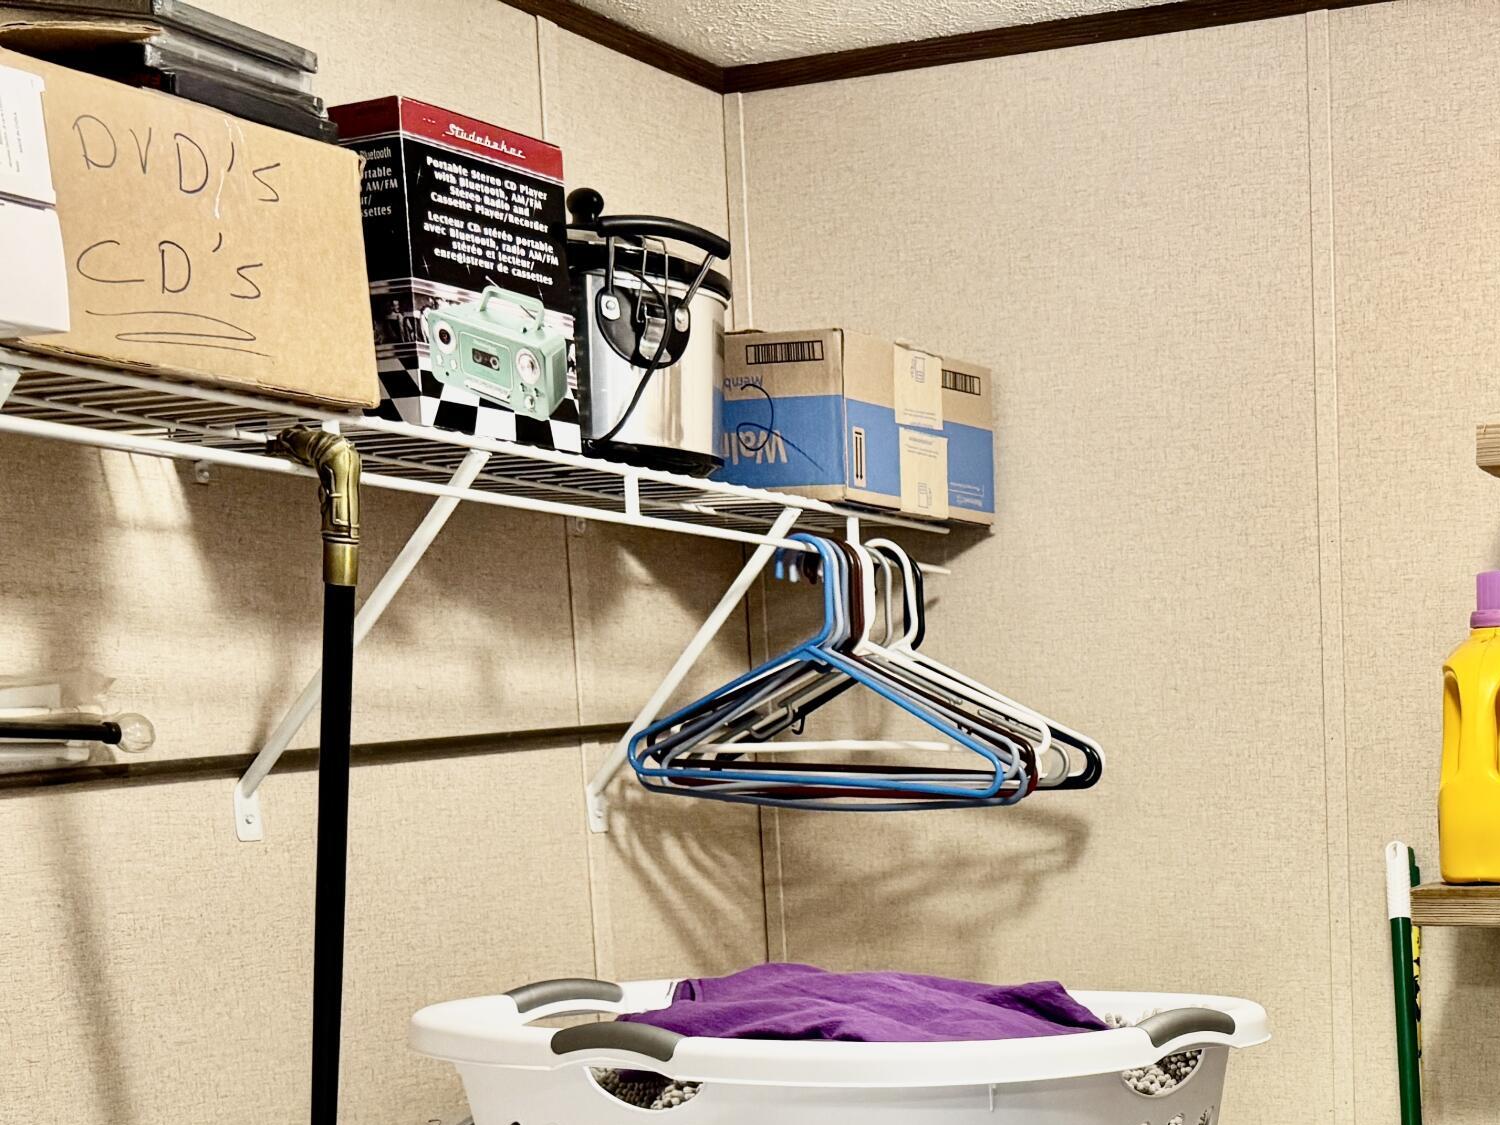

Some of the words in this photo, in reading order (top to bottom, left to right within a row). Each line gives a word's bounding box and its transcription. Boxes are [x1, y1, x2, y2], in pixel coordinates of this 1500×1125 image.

[72, 114, 281, 202] DVD's
[445, 123, 526, 159] Studebaker
[364, 166, 392, 179] rtable
[366, 178, 398, 191] AM/FM
[426, 155, 469, 177] Portable
[470, 169, 502, 187] Stereo
[504, 180, 517, 191] CD
[519, 184, 548, 200] Player
[433, 170, 457, 184] with
[458, 177, 509, 201] Bluetooth,
[511, 193, 542, 210] AM/FM
[430, 191, 473, 212] Cassette
[474, 203, 549, 233] Player/Recorder
[449, 185, 482, 203] Stereo
[483, 195, 510, 211] Radio
[512, 204, 530, 217] and
[423, 222, 447, 236] avec
[449, 228, 500, 250] Bluetooth,
[502, 242, 526, 257] radio
[528, 249, 559, 266] AM/FM
[427, 210, 465, 229] Lecteur
[467, 221, 481, 233] CD
[515, 236, 554, 254] portable
[76, 231, 263, 299] CD's
[433, 247, 495, 270] enregistreur
[496, 262, 509, 274] de
[511, 267, 554, 286] cassettes
[485, 249, 496, 260] et
[498, 251, 535, 271] lecteur/
